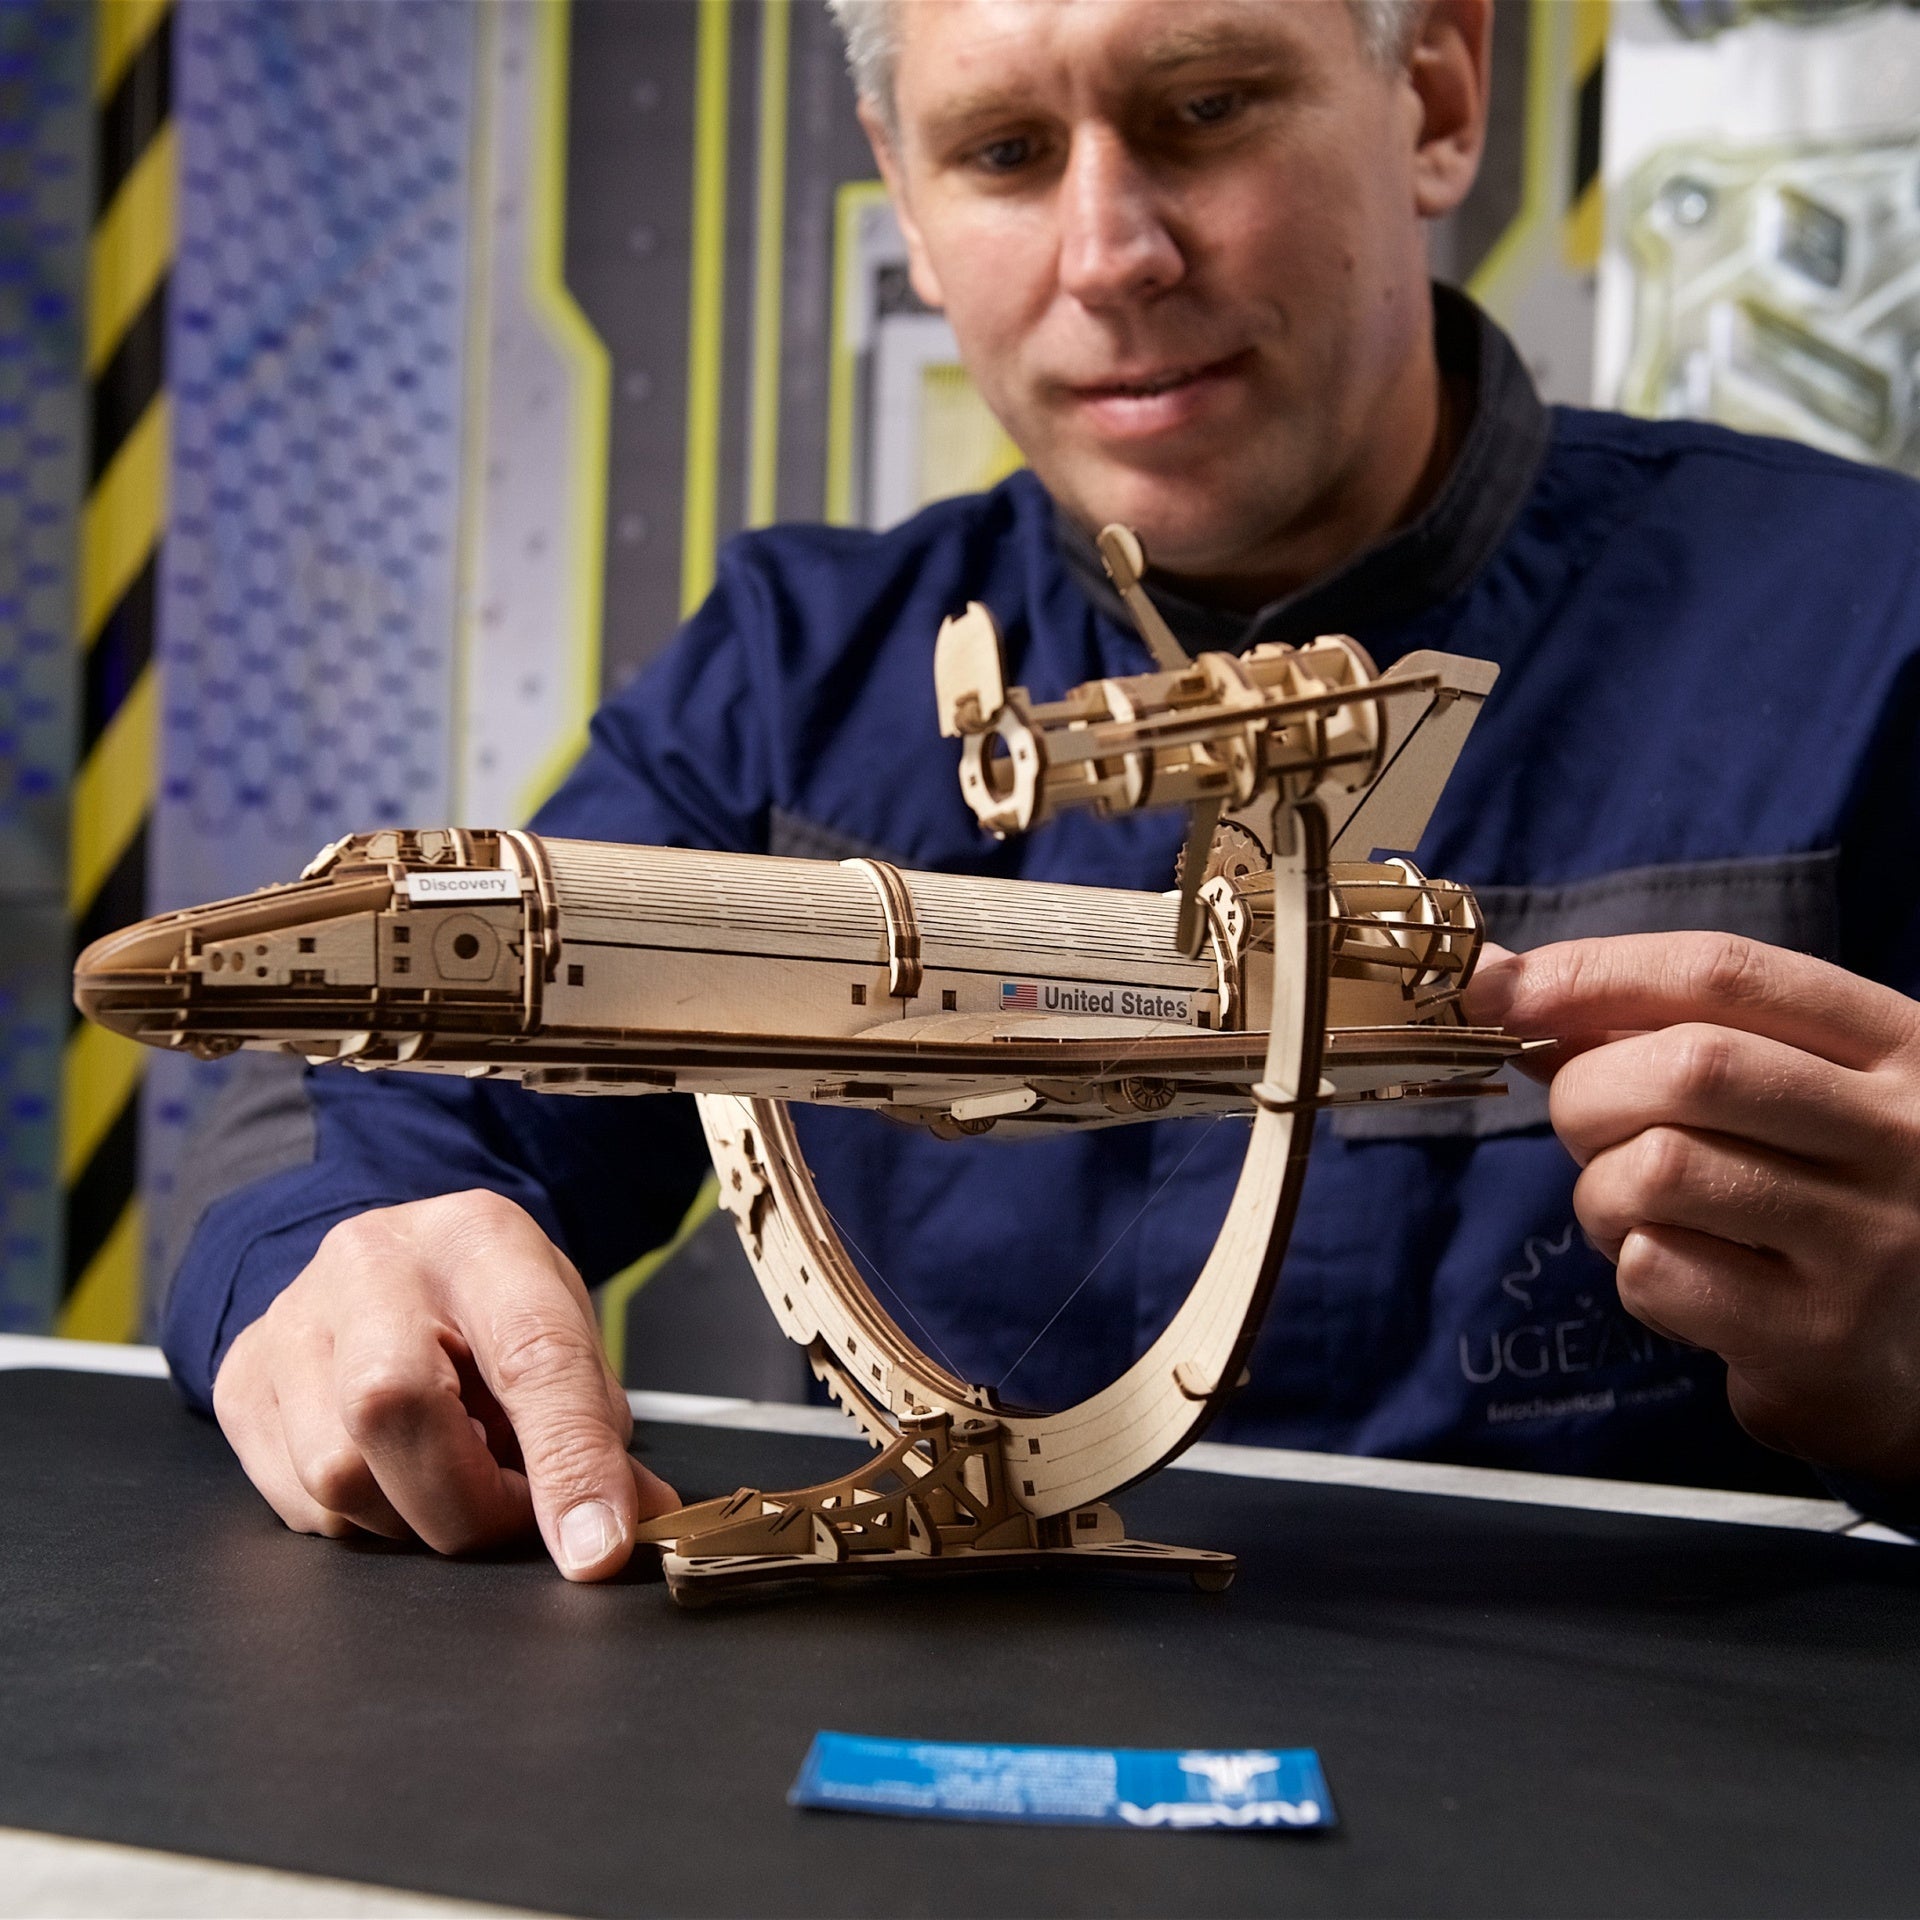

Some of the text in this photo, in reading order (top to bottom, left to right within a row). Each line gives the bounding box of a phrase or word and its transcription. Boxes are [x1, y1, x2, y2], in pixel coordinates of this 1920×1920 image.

[419, 878, 507, 892] Discovery
[1044, 986, 1188, 1019] United States
